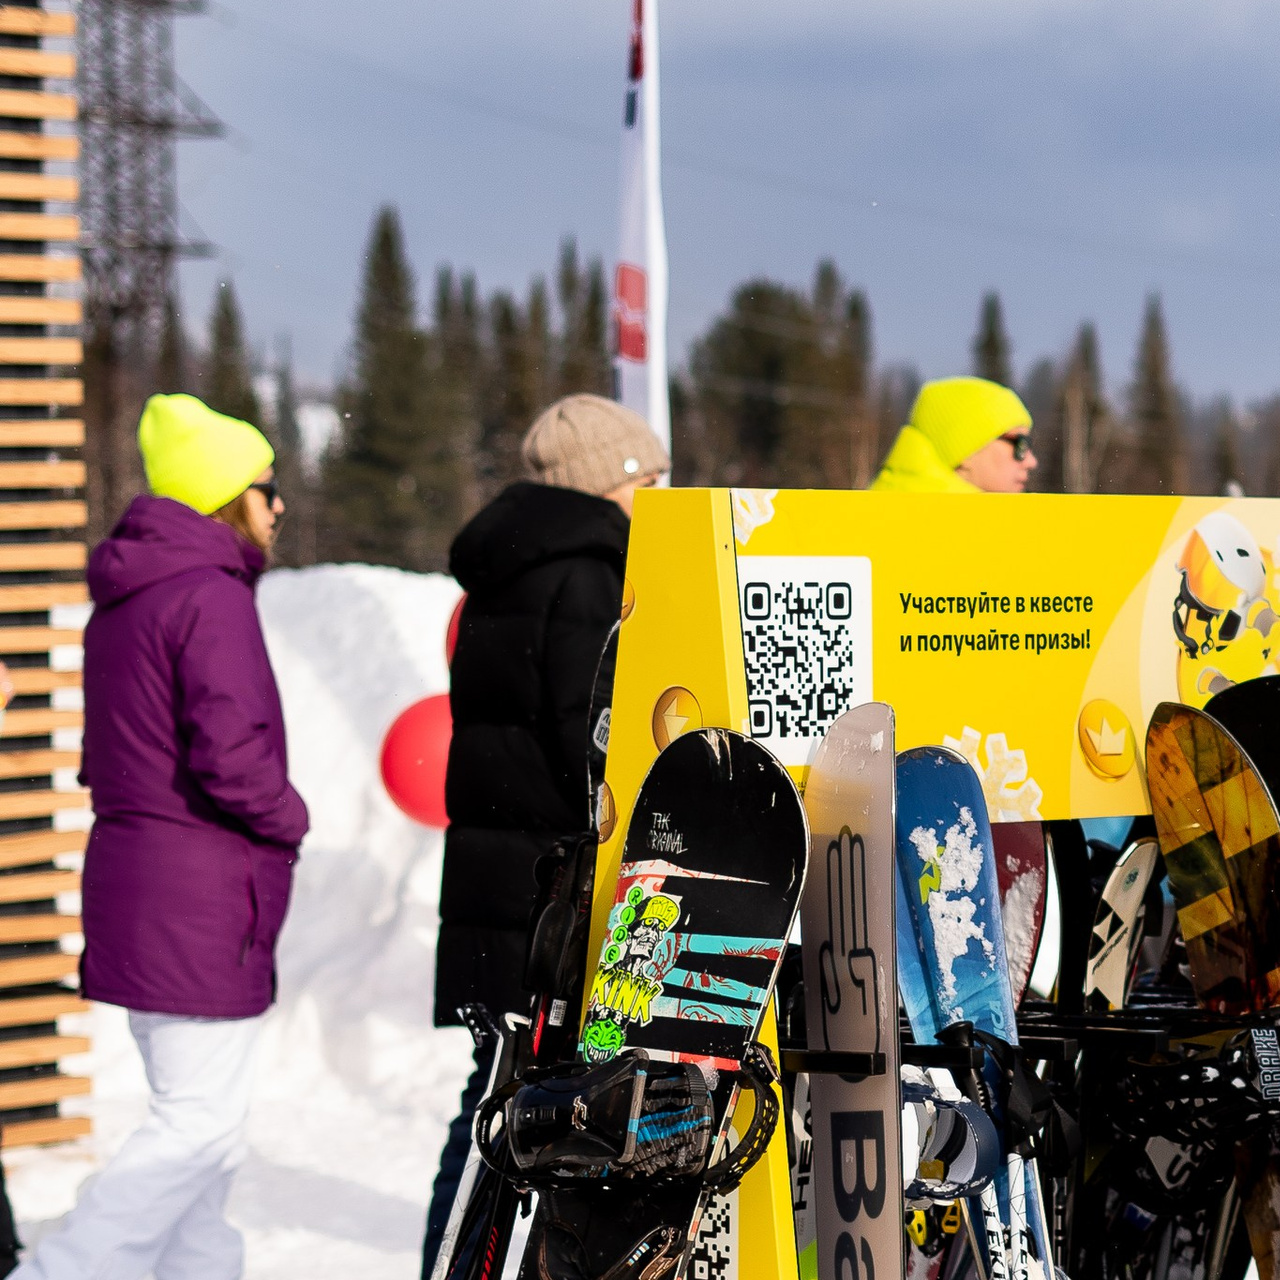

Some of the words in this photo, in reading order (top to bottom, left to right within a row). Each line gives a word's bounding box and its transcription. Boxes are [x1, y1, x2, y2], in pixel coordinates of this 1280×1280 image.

[899, 591, 1011, 619] Участвуйте
[1015, 595, 1026, 613] в
[1030, 595, 1094, 613] квесте
[900, 634, 912, 652] и
[917, 629, 1020, 657] получайте
[1024, 629, 1091, 655] призы!
[588, 963, 662, 1024] KINK
[983, 1208, 1006, 1280] LEKI
